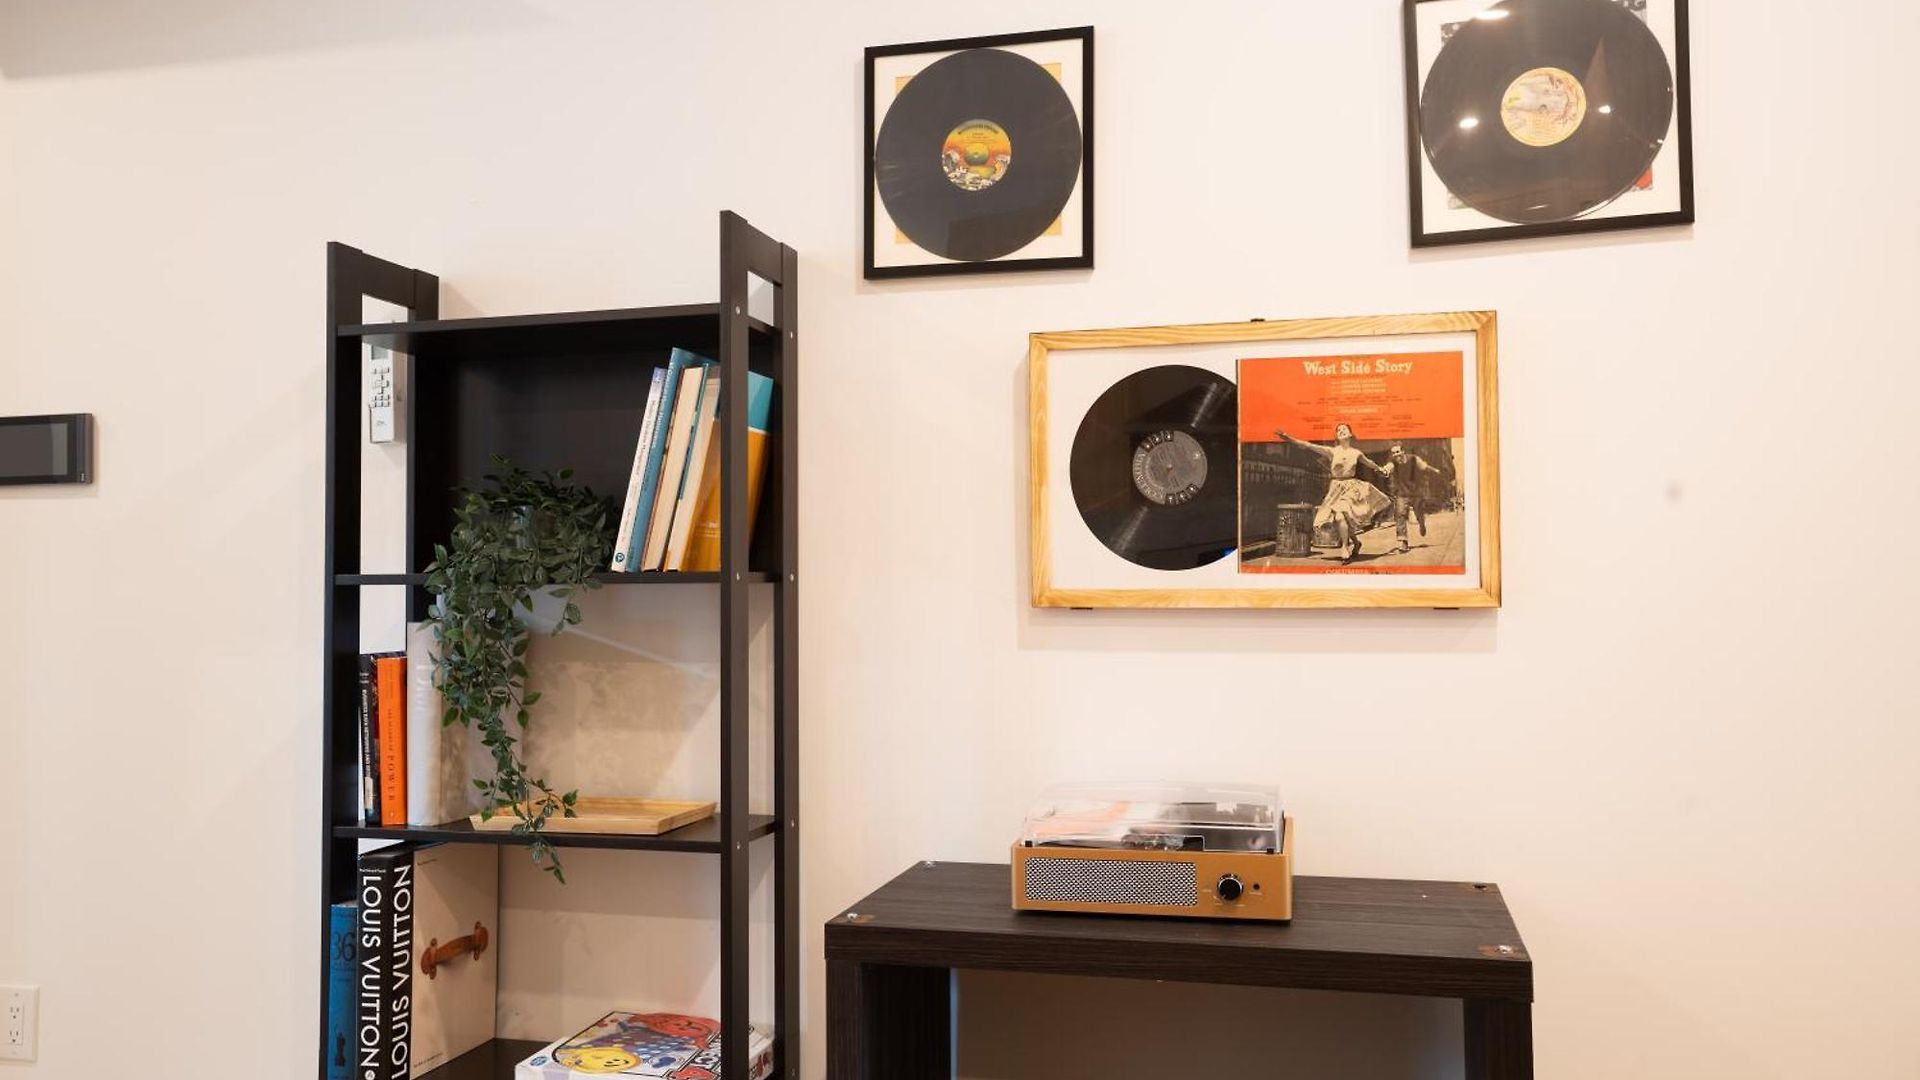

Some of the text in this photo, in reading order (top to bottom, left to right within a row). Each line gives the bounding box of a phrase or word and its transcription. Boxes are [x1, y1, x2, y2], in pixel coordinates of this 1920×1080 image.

[1303, 358, 1413, 375] West Side Story
[387, 755, 395, 801] POWER
[362, 876, 381, 947] LOUIS
[391, 865, 411, 1080] LOUIS VUITTON
[361, 956, 380, 1066] VUITTON
